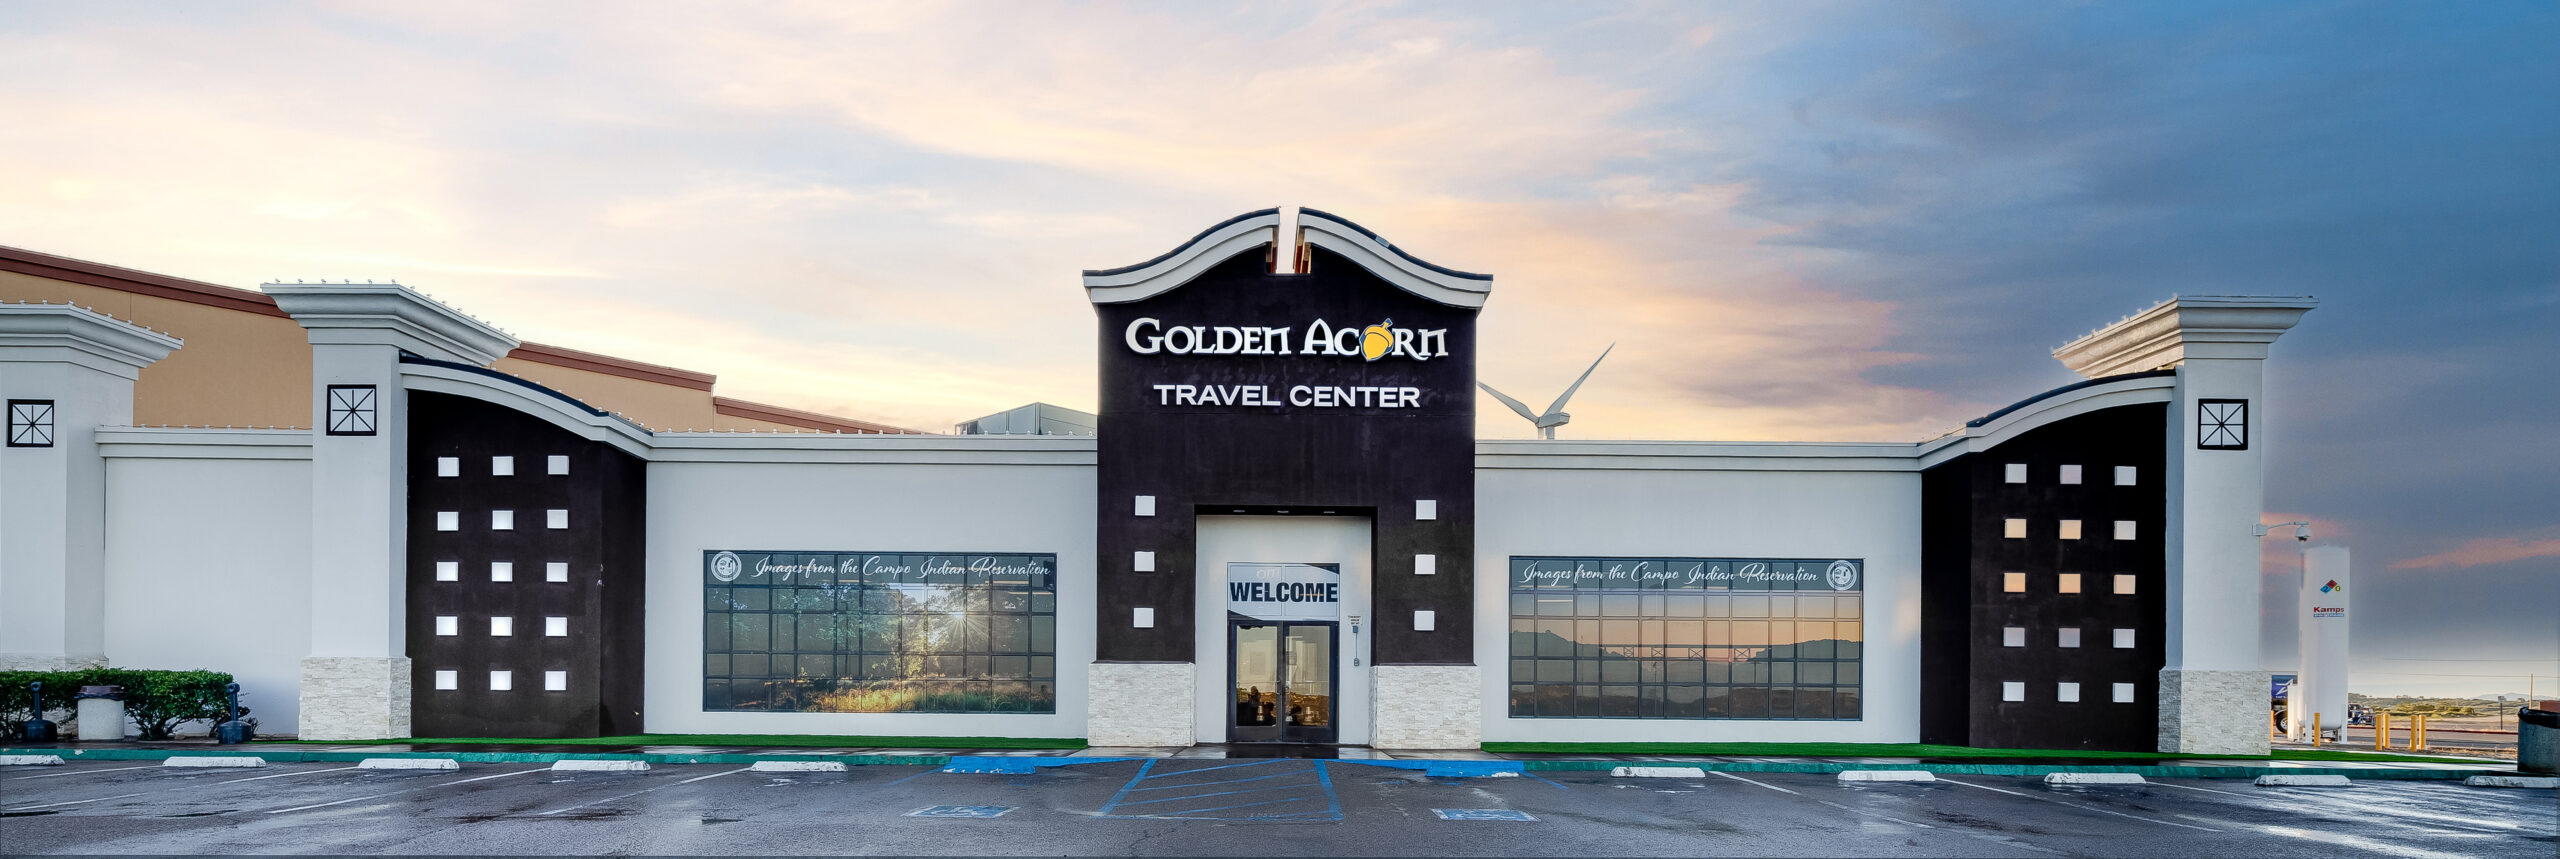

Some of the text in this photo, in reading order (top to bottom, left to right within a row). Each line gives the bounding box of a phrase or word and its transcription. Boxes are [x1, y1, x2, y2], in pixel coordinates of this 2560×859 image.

[1125, 317, 1291, 357] GOLDEN
[1153, 384, 1421, 408] TRAVEL CENTER
[750, 555, 803, 581] Images
[806, 558, 836, 578] from
[840, 558, 859, 574] the
[863, 555, 912, 579] Campo
[916, 556, 967, 578] Indian
[971, 556, 1051, 577] Reservation
[1519, 561, 1572, 586] Images
[1574, 563, 1604, 584] from
[1608, 563, 1627, 580] the
[1630, 561, 1679, 585] Campo
[1684, 562, 1735, 585] Indian
[1739, 562, 1819, 583] Reservation
[1230, 582, 1338, 602] WELCOME
